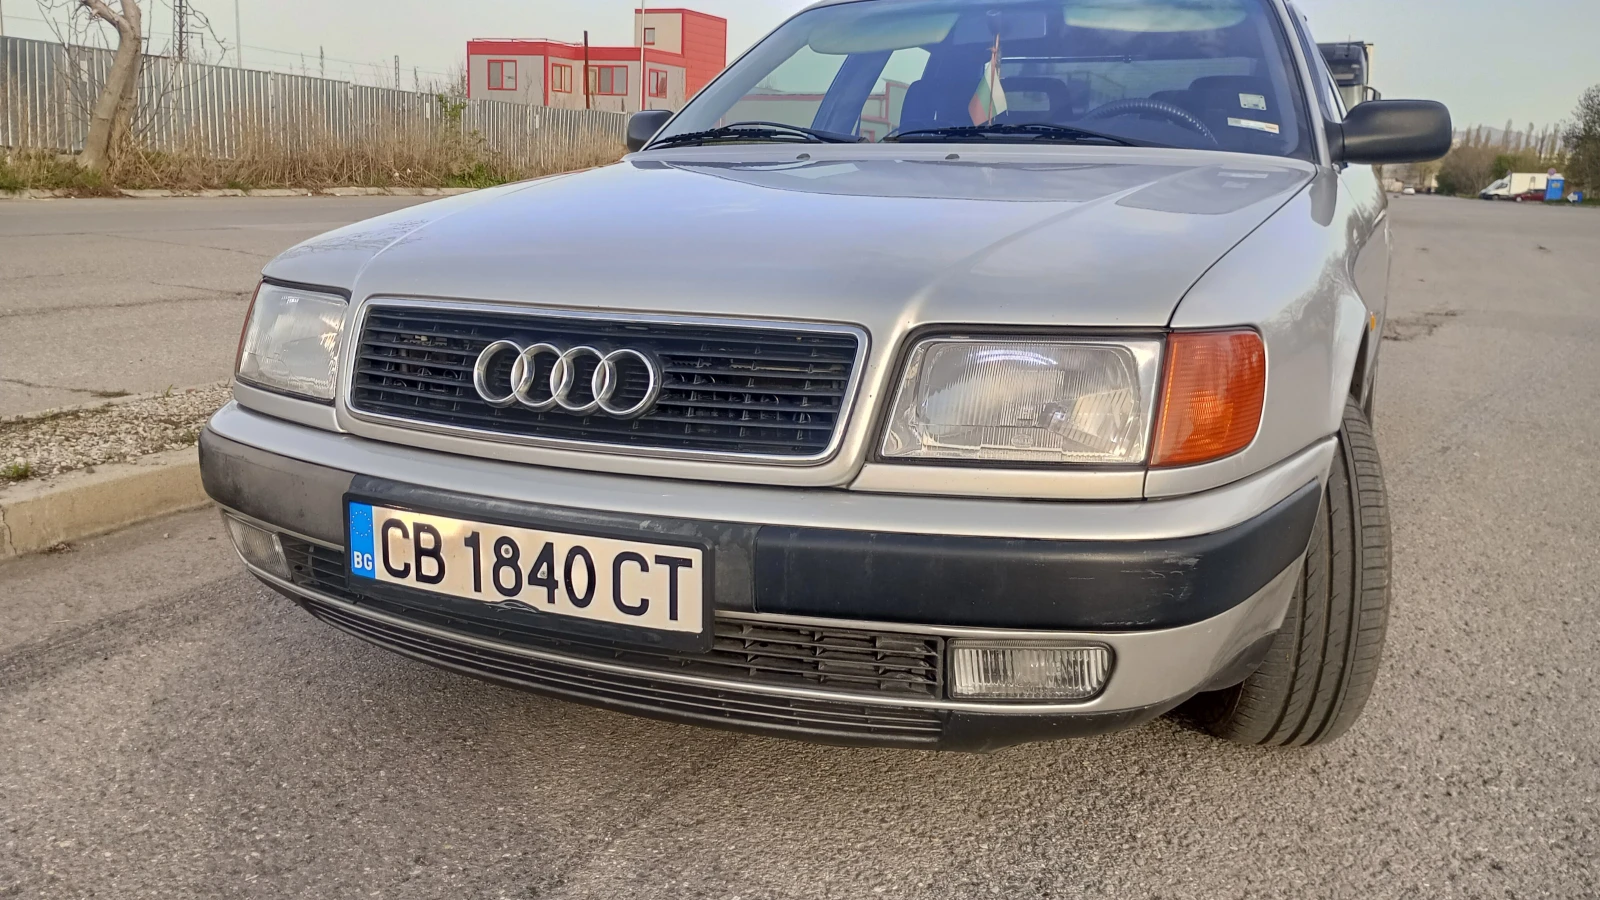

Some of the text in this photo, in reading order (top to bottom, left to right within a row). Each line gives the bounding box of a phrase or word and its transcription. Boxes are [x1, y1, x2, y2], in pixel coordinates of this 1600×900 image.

[354, 551, 373, 571] BG
[381, 518, 693, 621] CB 1840 CT
